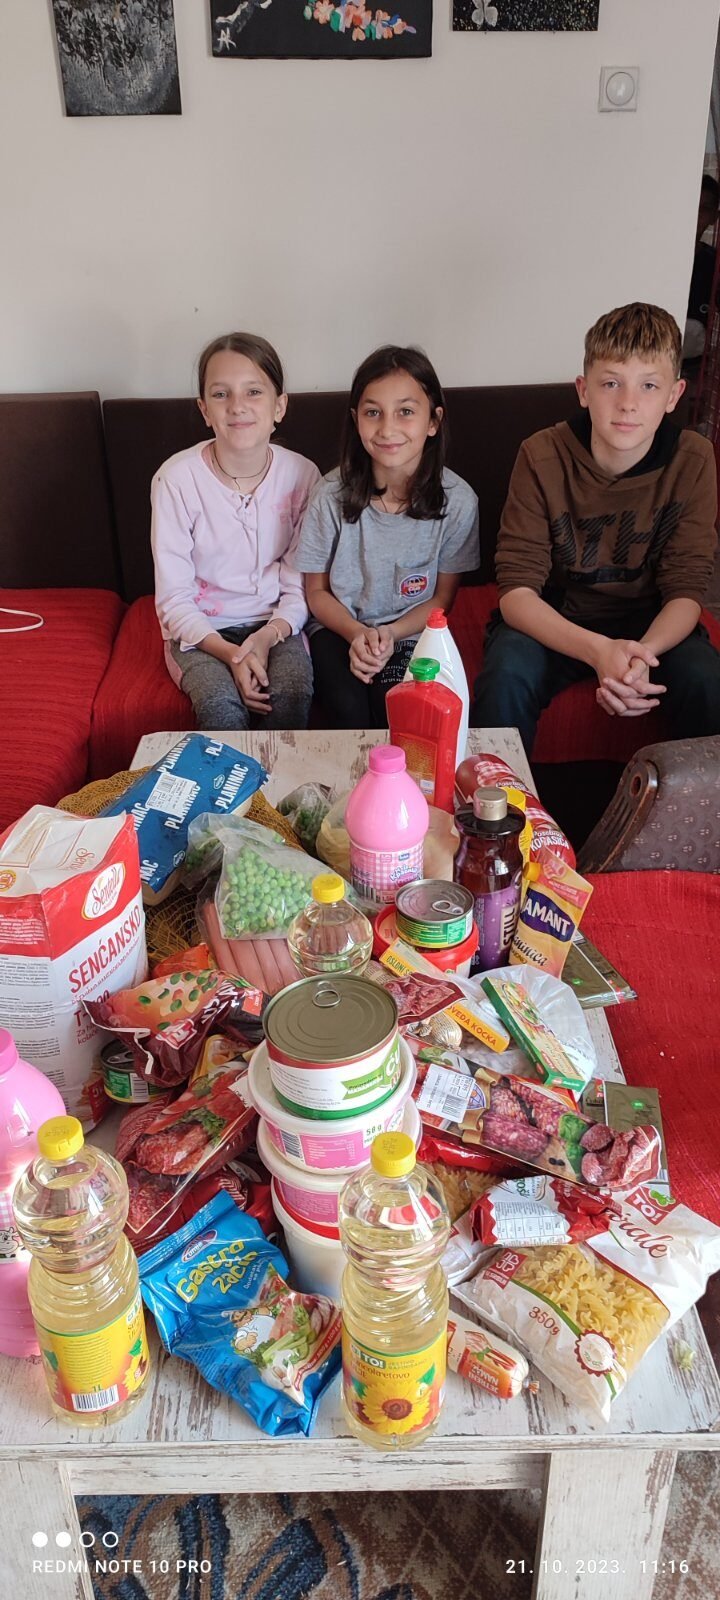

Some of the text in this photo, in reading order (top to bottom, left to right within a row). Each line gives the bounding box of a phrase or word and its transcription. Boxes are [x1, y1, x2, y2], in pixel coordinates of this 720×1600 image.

[214, 763, 249, 810] PLANINAC
[503, 907, 516, 946] STILL
[470, 1022, 497, 1046] KOCKA
[632, 1193, 663, 1222] TO!
[176, 1240, 245, 1303] Gastro
[528, 1306, 561, 1336] 350g
[363, 1353, 384, 1369] TO!
